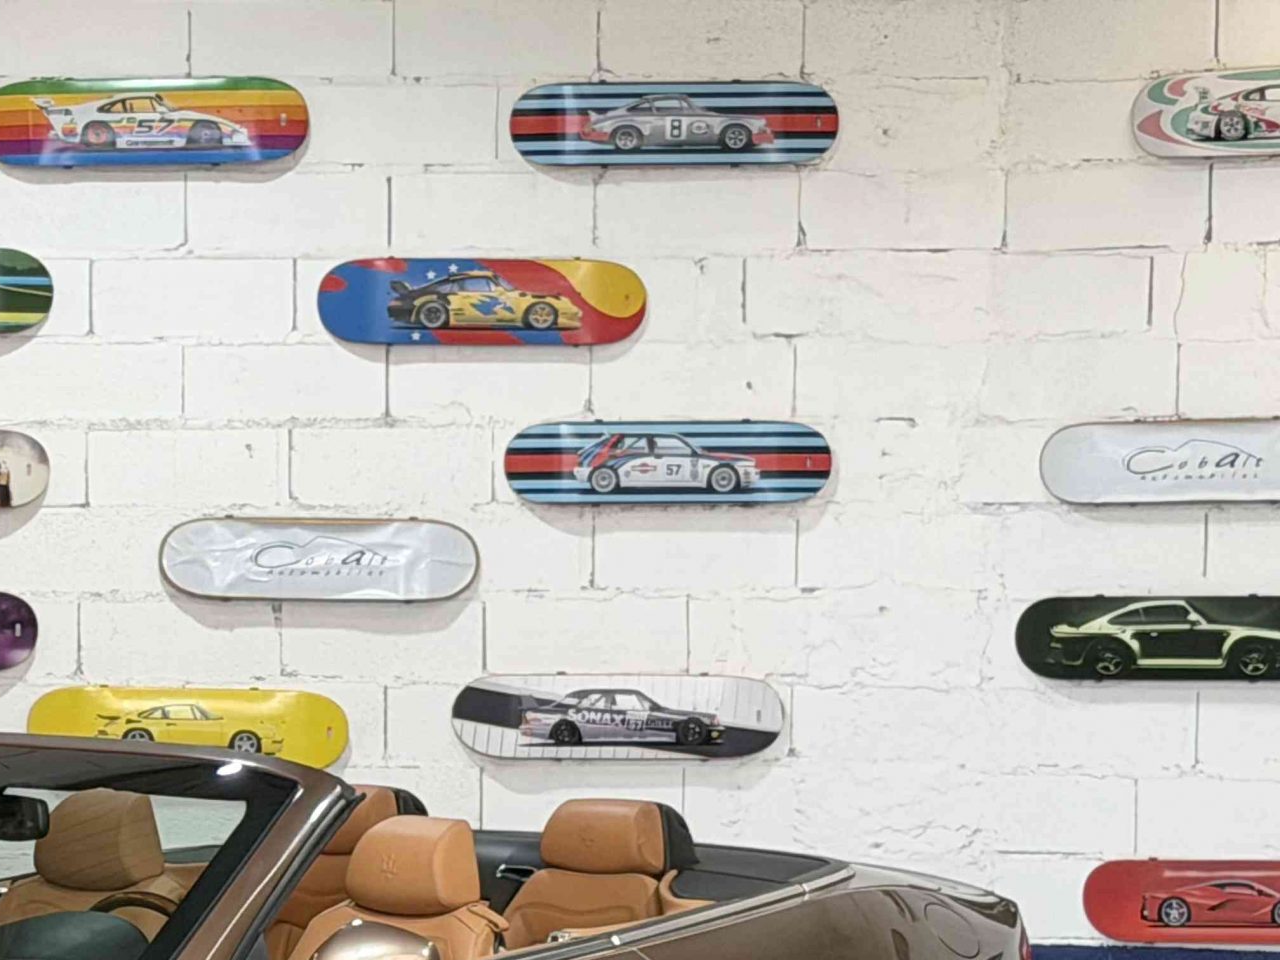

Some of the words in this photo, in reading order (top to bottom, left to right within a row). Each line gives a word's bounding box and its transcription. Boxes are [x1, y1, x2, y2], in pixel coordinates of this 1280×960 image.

[134, 118, 176, 135] 57
[670, 118, 683, 139] 8
[665, 463, 682, 476] 57
[567, 708, 625, 727] SONAX
